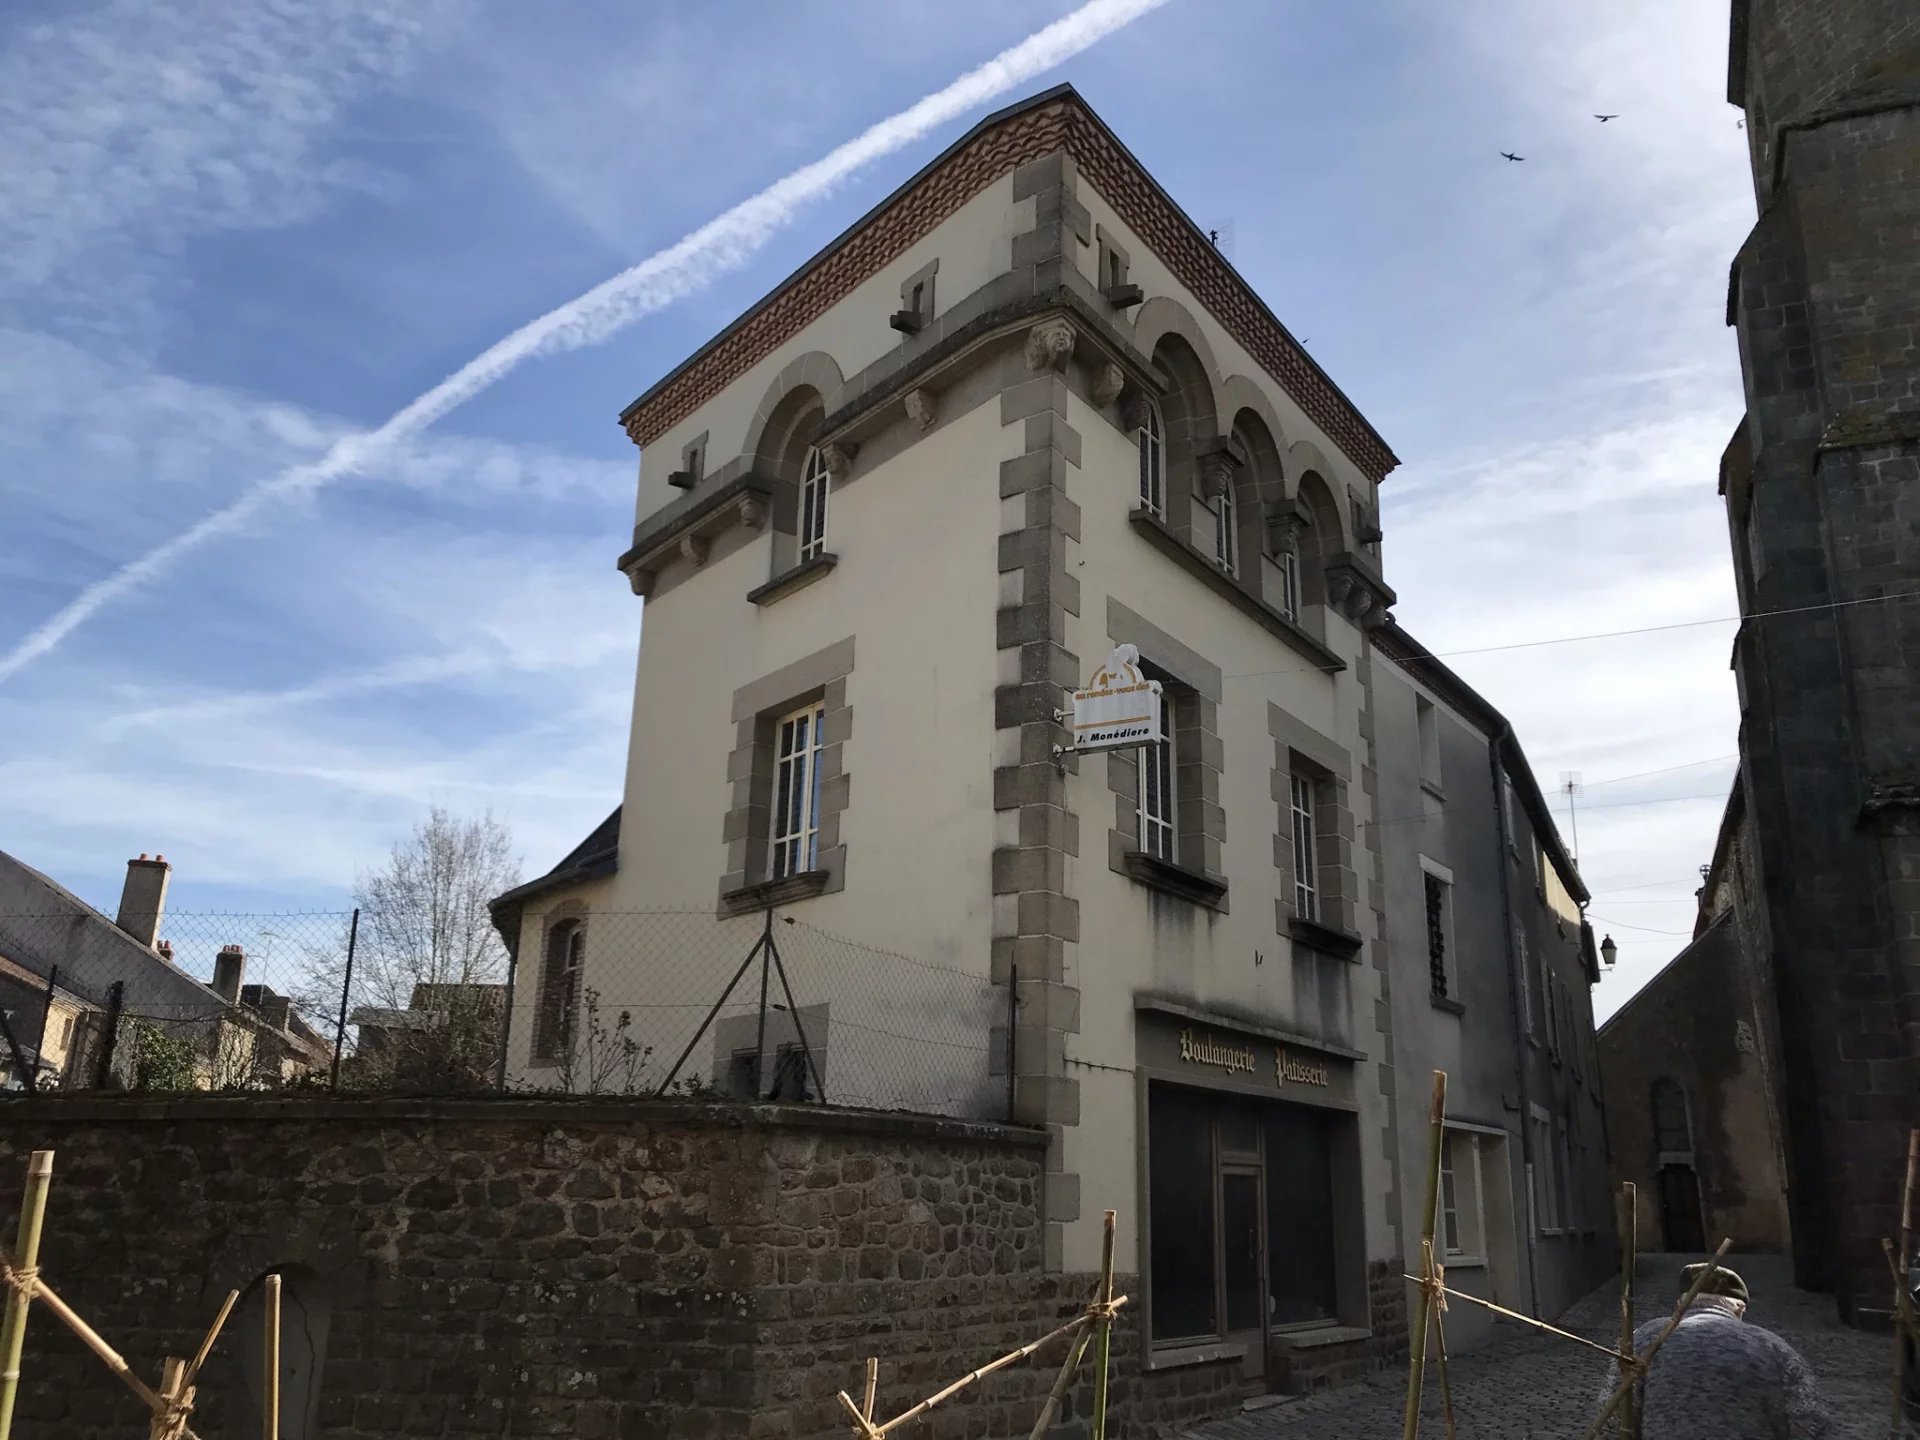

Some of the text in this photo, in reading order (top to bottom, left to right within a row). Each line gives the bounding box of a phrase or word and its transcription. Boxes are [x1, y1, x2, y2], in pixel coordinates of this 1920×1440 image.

[1086, 685, 1135, 698] rendez-vous
[1136, 682, 1150, 691] des
[1077, 734, 1086, 743] J.
[1179, 1028, 1328, 1088] Boulangerie Patisserie
